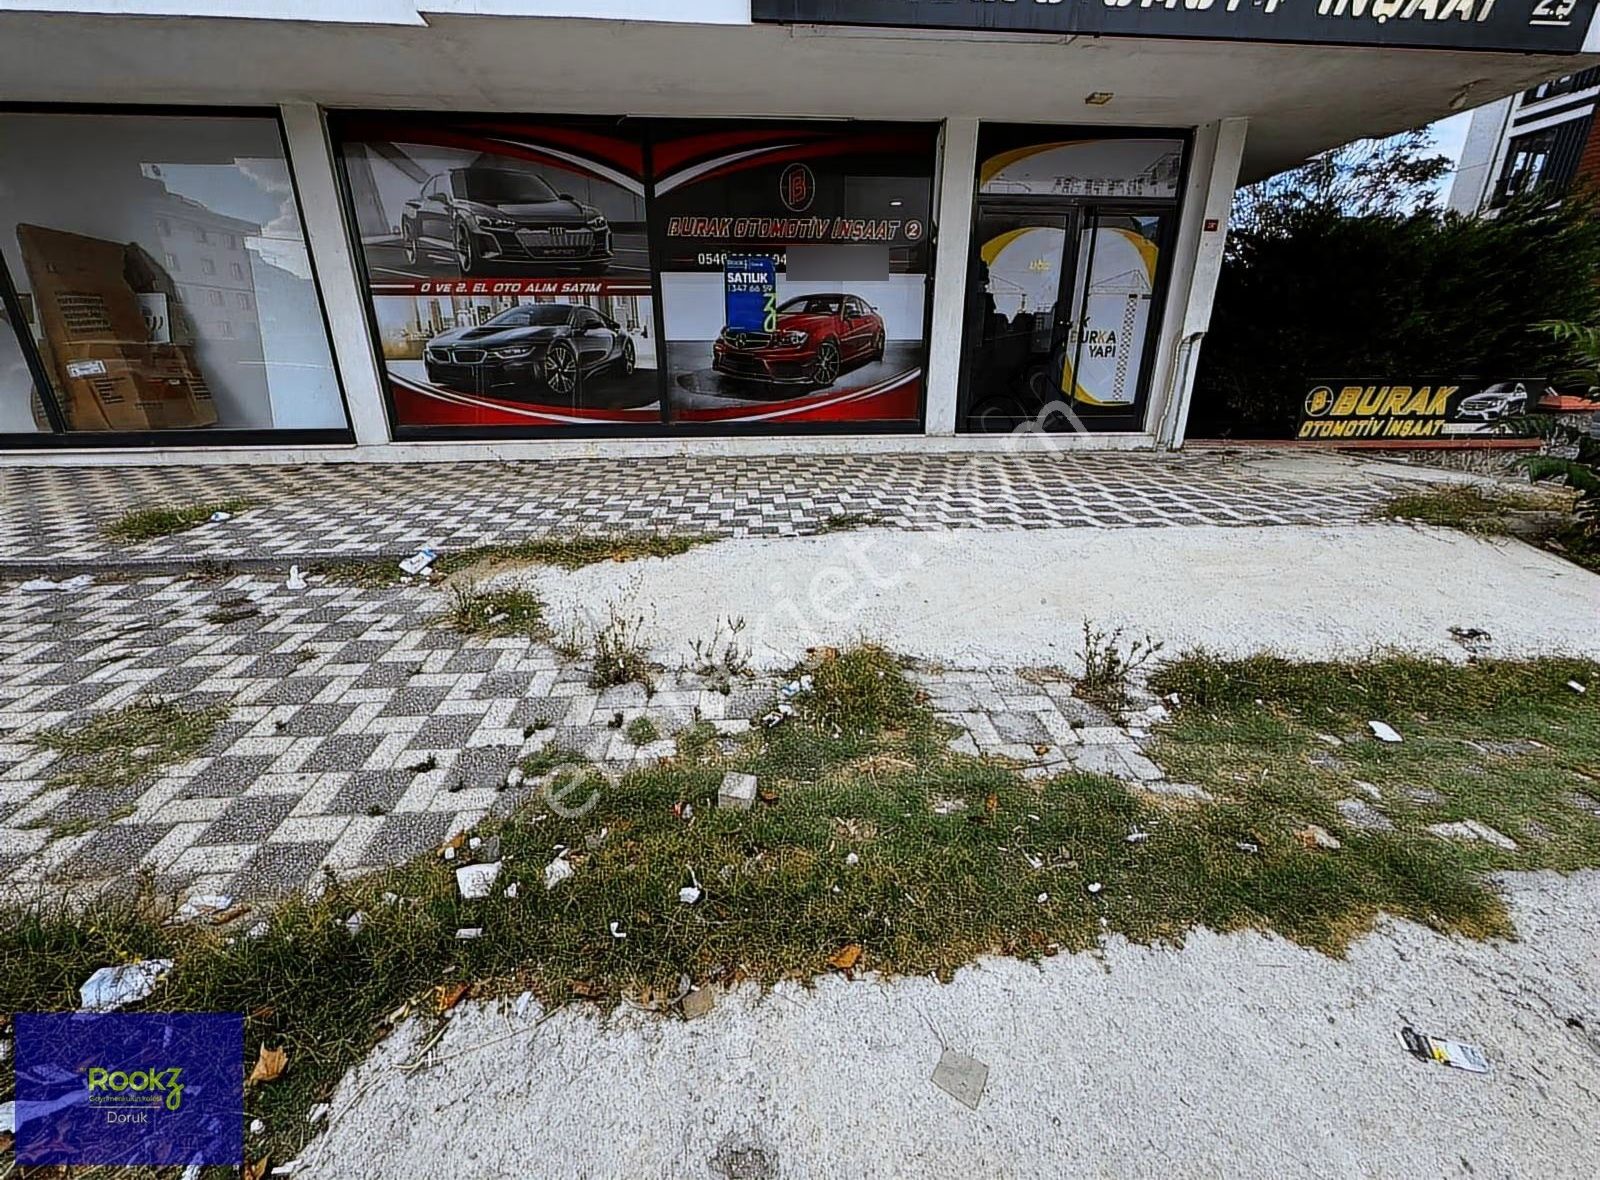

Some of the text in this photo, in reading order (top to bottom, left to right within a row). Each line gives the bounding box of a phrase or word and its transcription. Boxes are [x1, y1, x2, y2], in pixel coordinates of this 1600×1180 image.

[667, 217, 733, 238] BURAK
[734, 216, 830, 239] OTOMOTİV
[727, 272, 768, 284] SATILIK
[435, 283, 452, 292] VE
[455, 283, 467, 292] 2.
[472, 283, 488, 292] EL
[493, 283, 522, 292] OTO
[524, 283, 558, 292] ALIM
[561, 283, 602, 292] SATIM
[1089, 345, 1116, 358] YAPI
[1330, 386, 1459, 416] BURAK
[1299, 416, 1385, 437] OTOMOTİV
